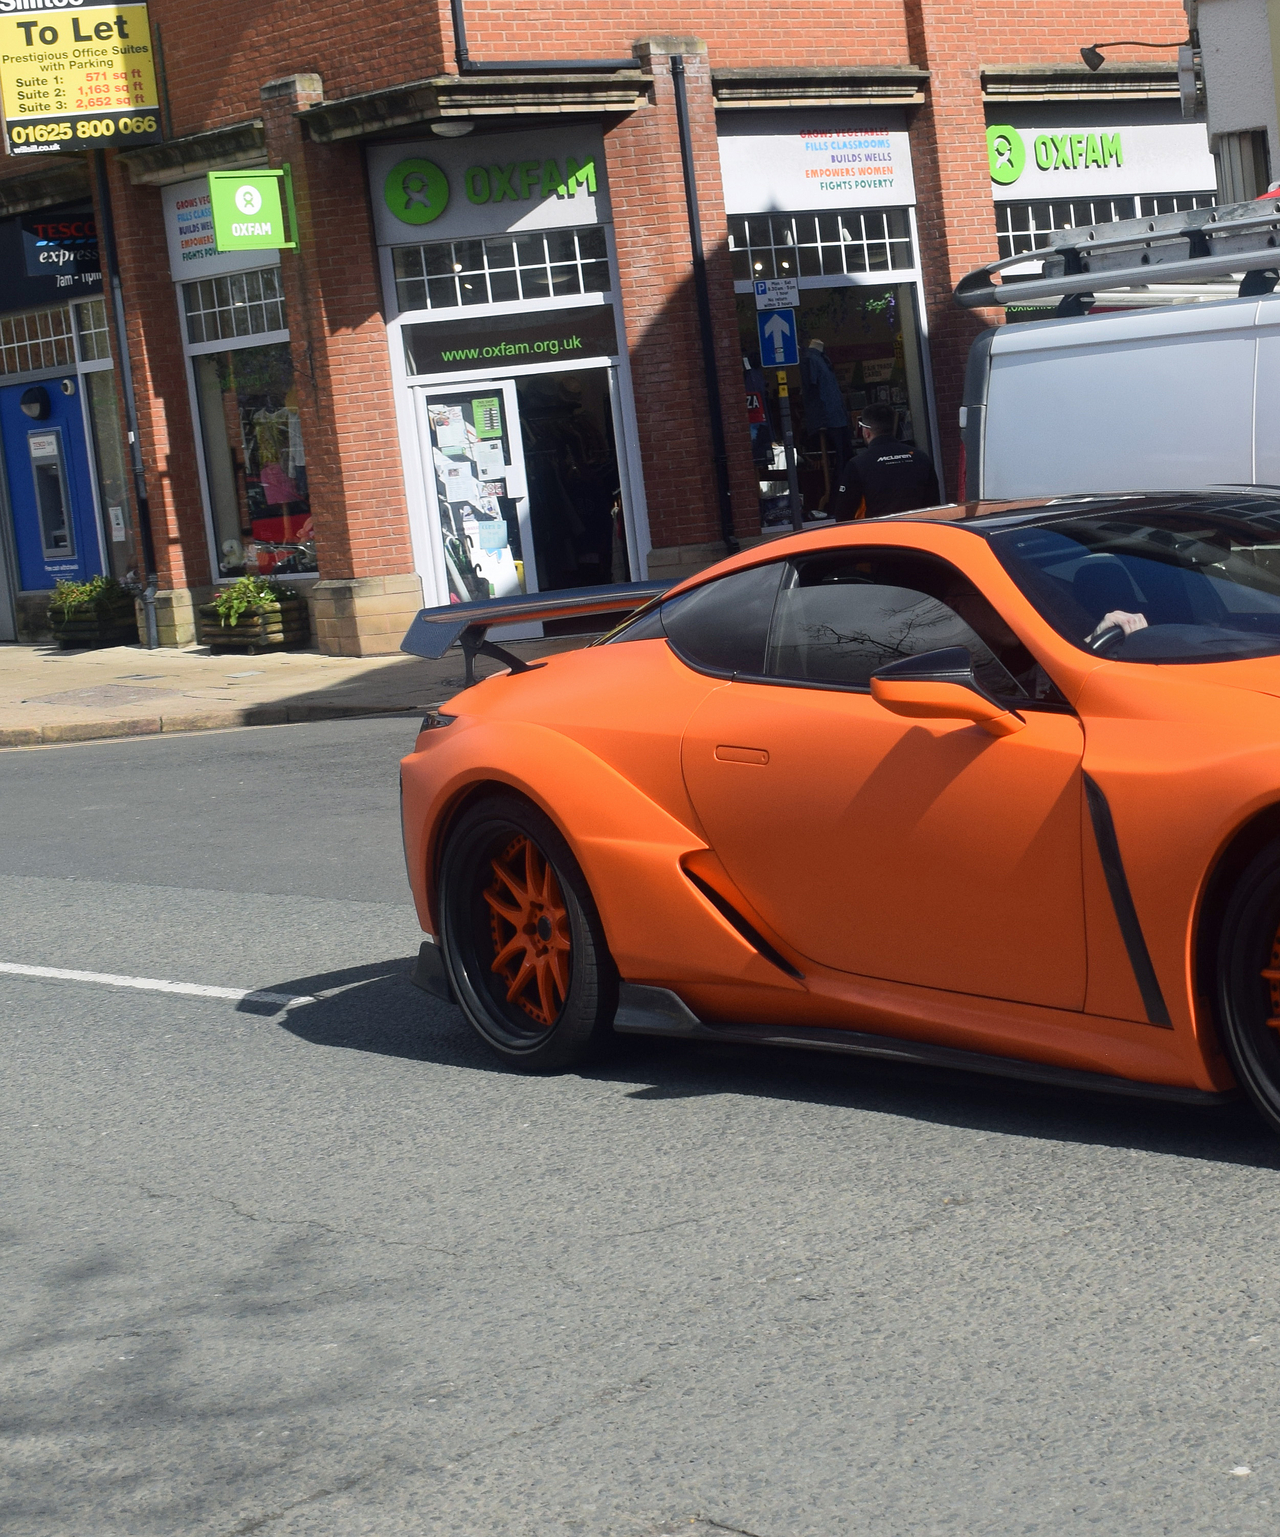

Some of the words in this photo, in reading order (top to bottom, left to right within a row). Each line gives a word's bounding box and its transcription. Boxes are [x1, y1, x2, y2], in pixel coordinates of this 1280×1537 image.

[16, 20, 59, 46] To
[72, 15, 129, 42] Let
[2, 51, 69, 64] Prestigious
[72, 48, 108, 58] Office
[112, 44, 148, 55] Suites
[40, 62, 64, 72] with
[70, 58, 114, 70] Parking
[16, 78, 48, 88] Suite
[54, 76, 64, 84] 1:
[86, 72, 107, 82] 571
[113, 72, 128, 82] sq
[132, 69, 142, 78] ft
[18, 90, 50, 100] Suite
[54, 88, 66, 97] 2:
[78, 84, 110, 96] 1,163
[115, 84, 130, 94] sq
[133, 82, 143, 91] ft
[19, 103, 50, 112] Suite
[56, 101, 67, 110] 3:
[76, 96, 112, 109] 2,652
[116, 98, 131, 106] sq
[134, 94, 144, 103] ft
[12, 122, 72, 144] 01625
[76, 118, 115, 138] 800
[118, 116, 157, 134] 066
[800, 128, 832, 138] GROWS
[834, 126, 890, 138] VEGETABLES
[806, 141, 828, 151] FILLS
[831, 140, 890, 150] CLASSROOMS
[1034, 132, 1124, 171] OXFAM
[830, 154, 862, 163] BUILDS
[864, 152, 892, 162] WELLS
[805, 168, 856, 178] EMPOWERS
[858, 166, 894, 176] WOMEN
[465, 155, 597, 205] OXFAM
[820, 180, 852, 190] FIGHTS
[854, 178, 894, 189] POVERTY
[176, 196, 198, 210] GROWS
[177, 212, 192, 223] FILLS
[33, 222, 97, 238] TESCO
[178, 222, 200, 236] BUILDS
[232, 222, 272, 236] OXFAM
[39, 248, 99, 266] express
[182, 249, 204, 262] FIGHTS
[56, 274, 74, 288] 7am
[758, 284, 766, 294] P
[442, 335, 582, 362] www.oxfam.org.uk
